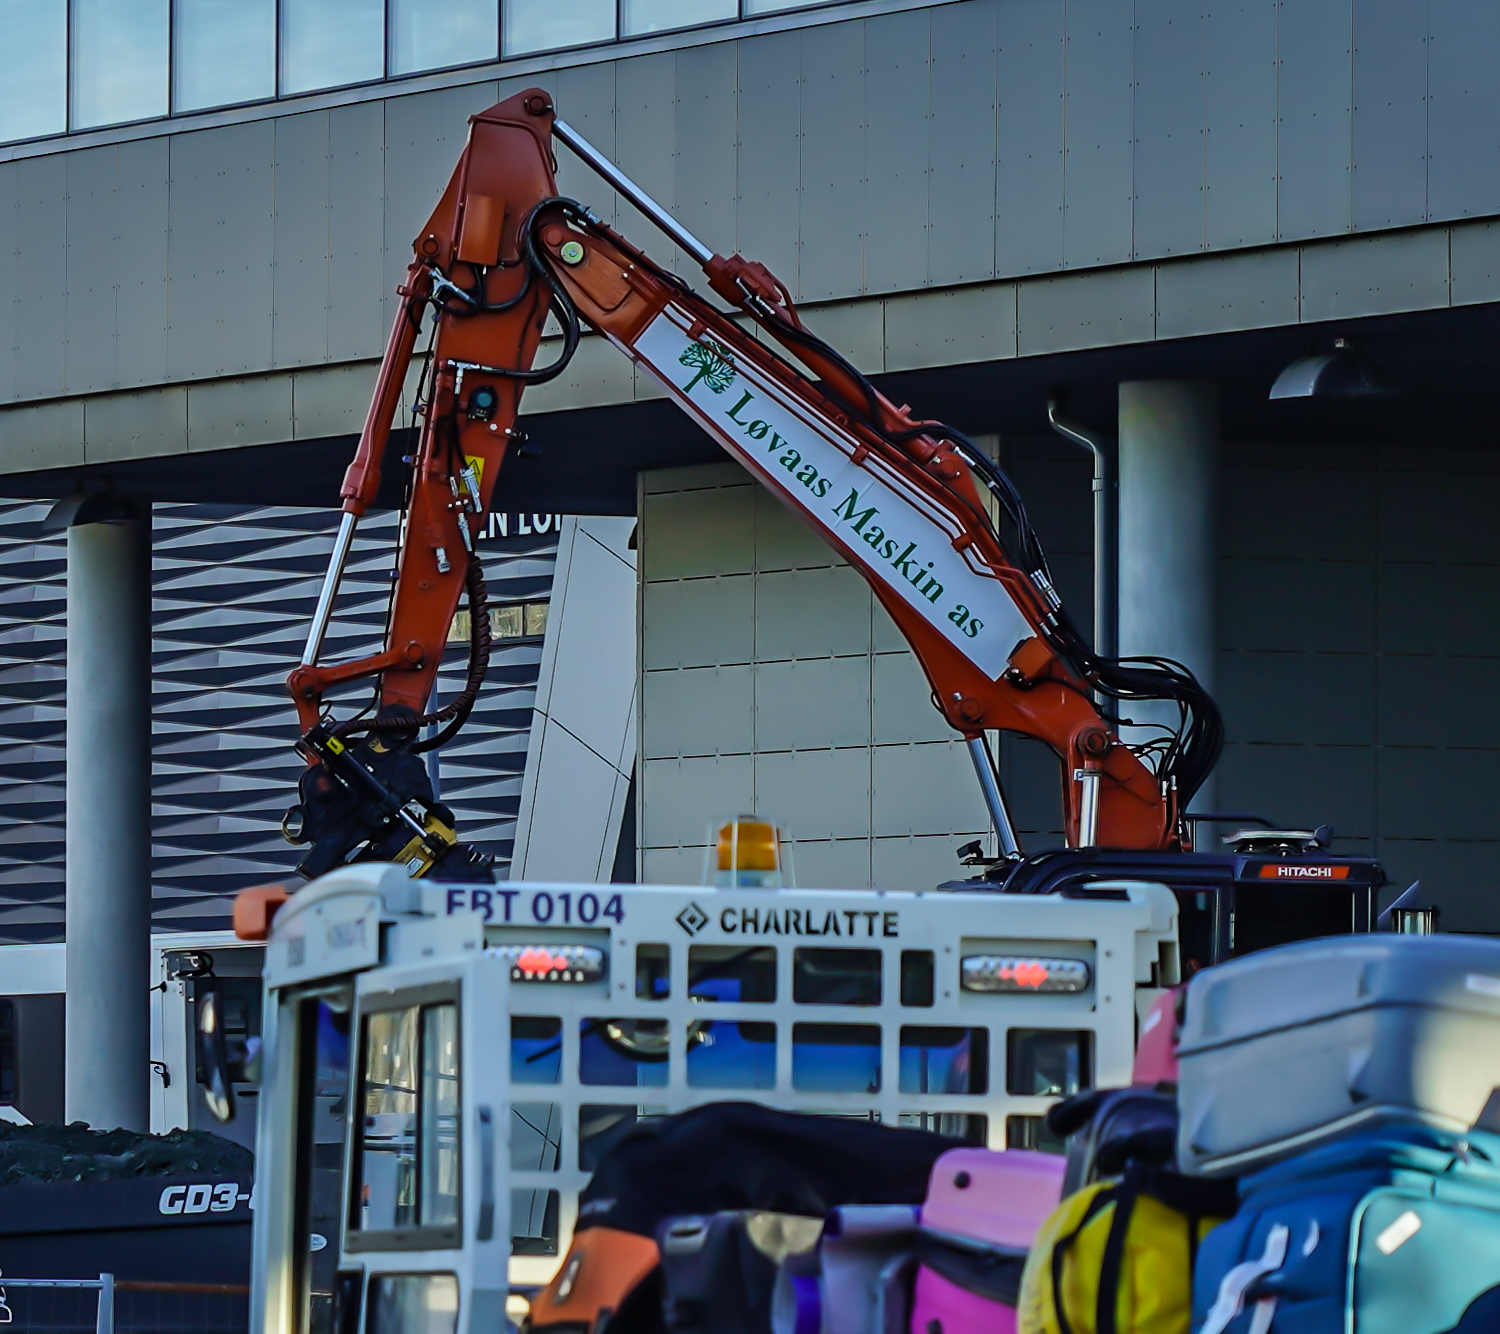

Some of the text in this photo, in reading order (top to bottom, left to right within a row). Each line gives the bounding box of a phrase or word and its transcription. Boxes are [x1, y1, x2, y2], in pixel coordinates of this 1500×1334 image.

[724, 388, 985, 639] Løvaas Maskin as
[1277, 866, 1332, 877] HITACHI
[532, 892, 625, 924] 0104
[720, 907, 899, 937] CHARLATTE
[159, 1182, 257, 1215] GD3-
